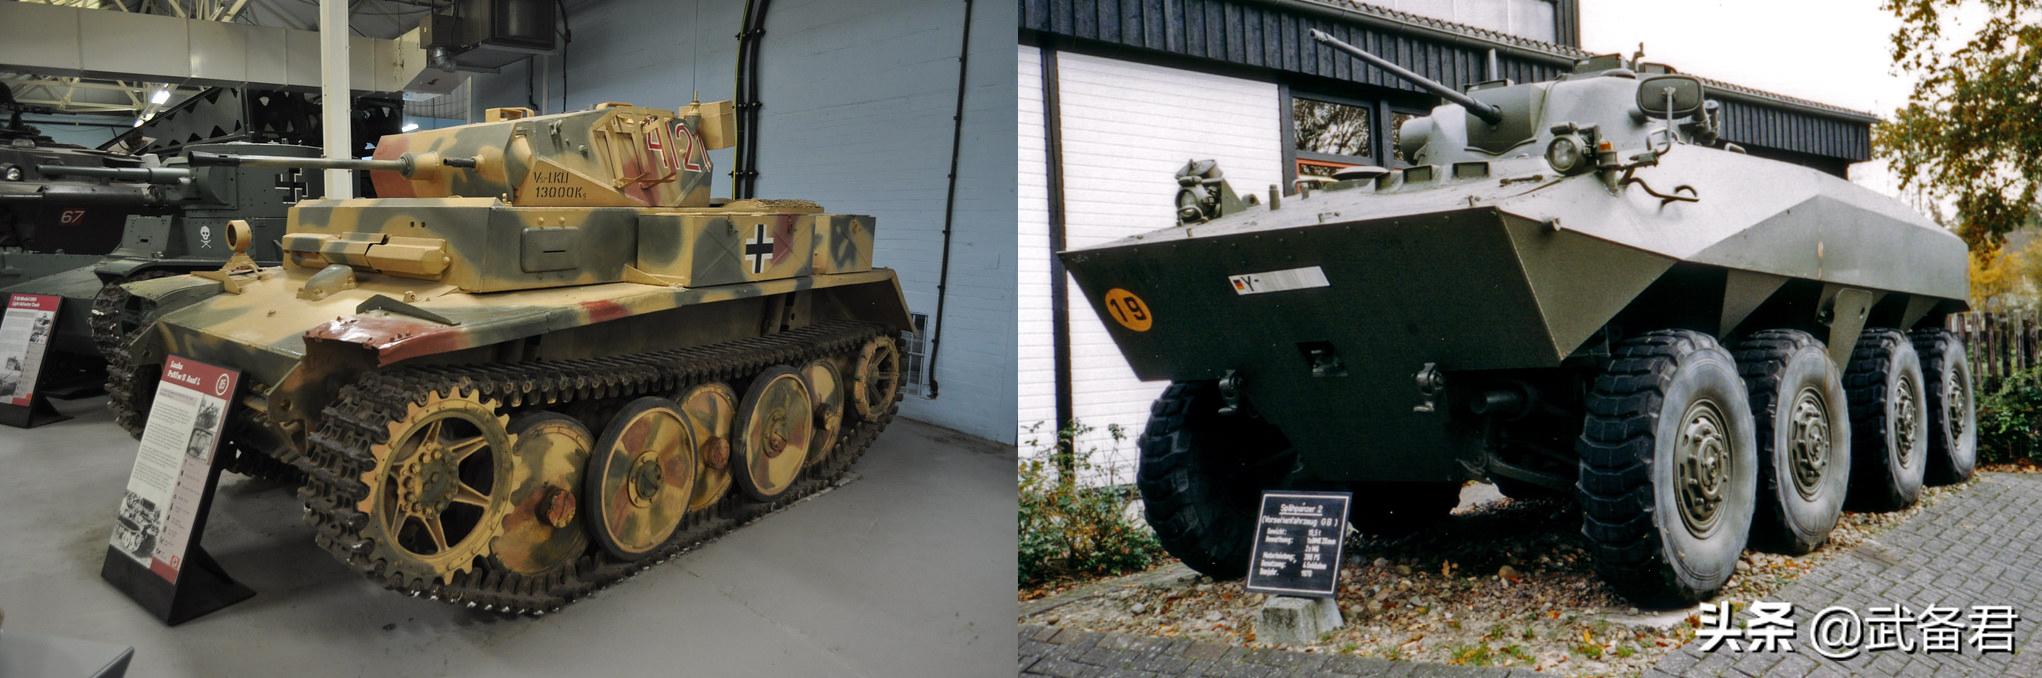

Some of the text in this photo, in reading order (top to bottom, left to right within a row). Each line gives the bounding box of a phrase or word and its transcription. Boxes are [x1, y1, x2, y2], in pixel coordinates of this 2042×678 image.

[60, 210, 86, 224] 67
[1109, 296, 1148, 323] 19
[1317, 504, 1324, 513] 2
